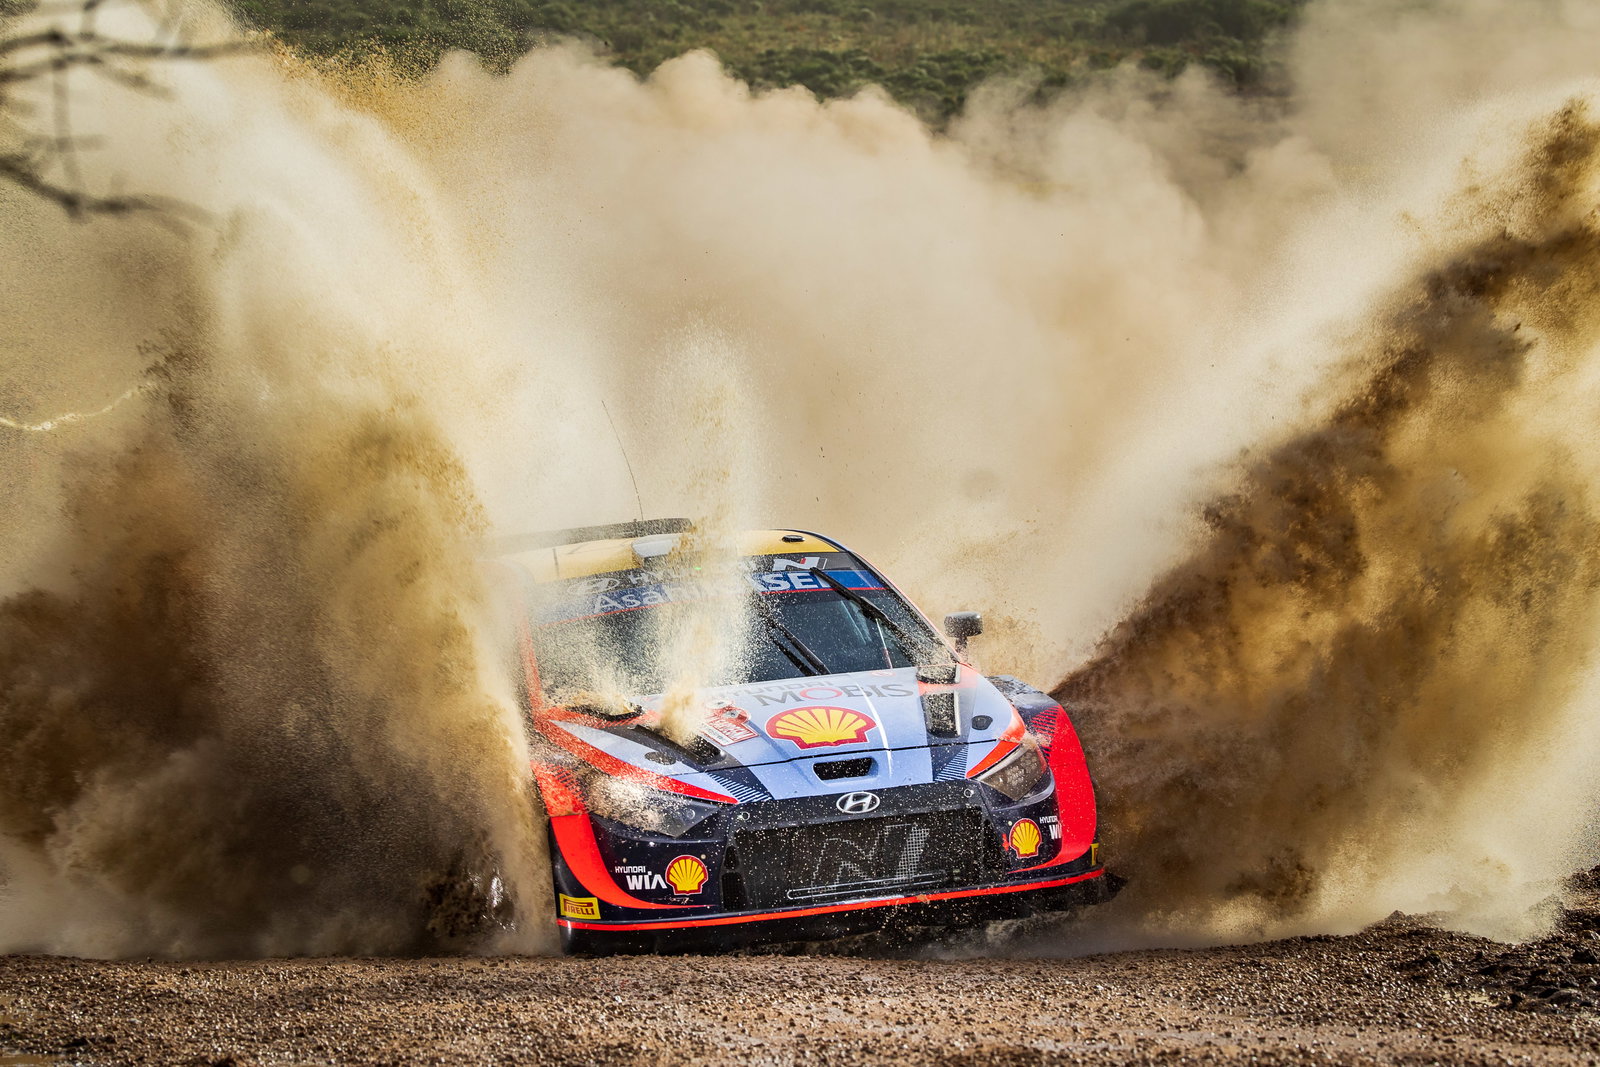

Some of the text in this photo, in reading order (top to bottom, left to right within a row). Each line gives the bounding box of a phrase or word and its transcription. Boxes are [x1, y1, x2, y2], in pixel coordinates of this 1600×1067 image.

[724, 681, 834, 697] YUNDAI
[753, 684, 914, 706] MOBIS
[615, 865, 646, 874] HYUNDAI
[563, 898, 595, 916] PIRELLI
